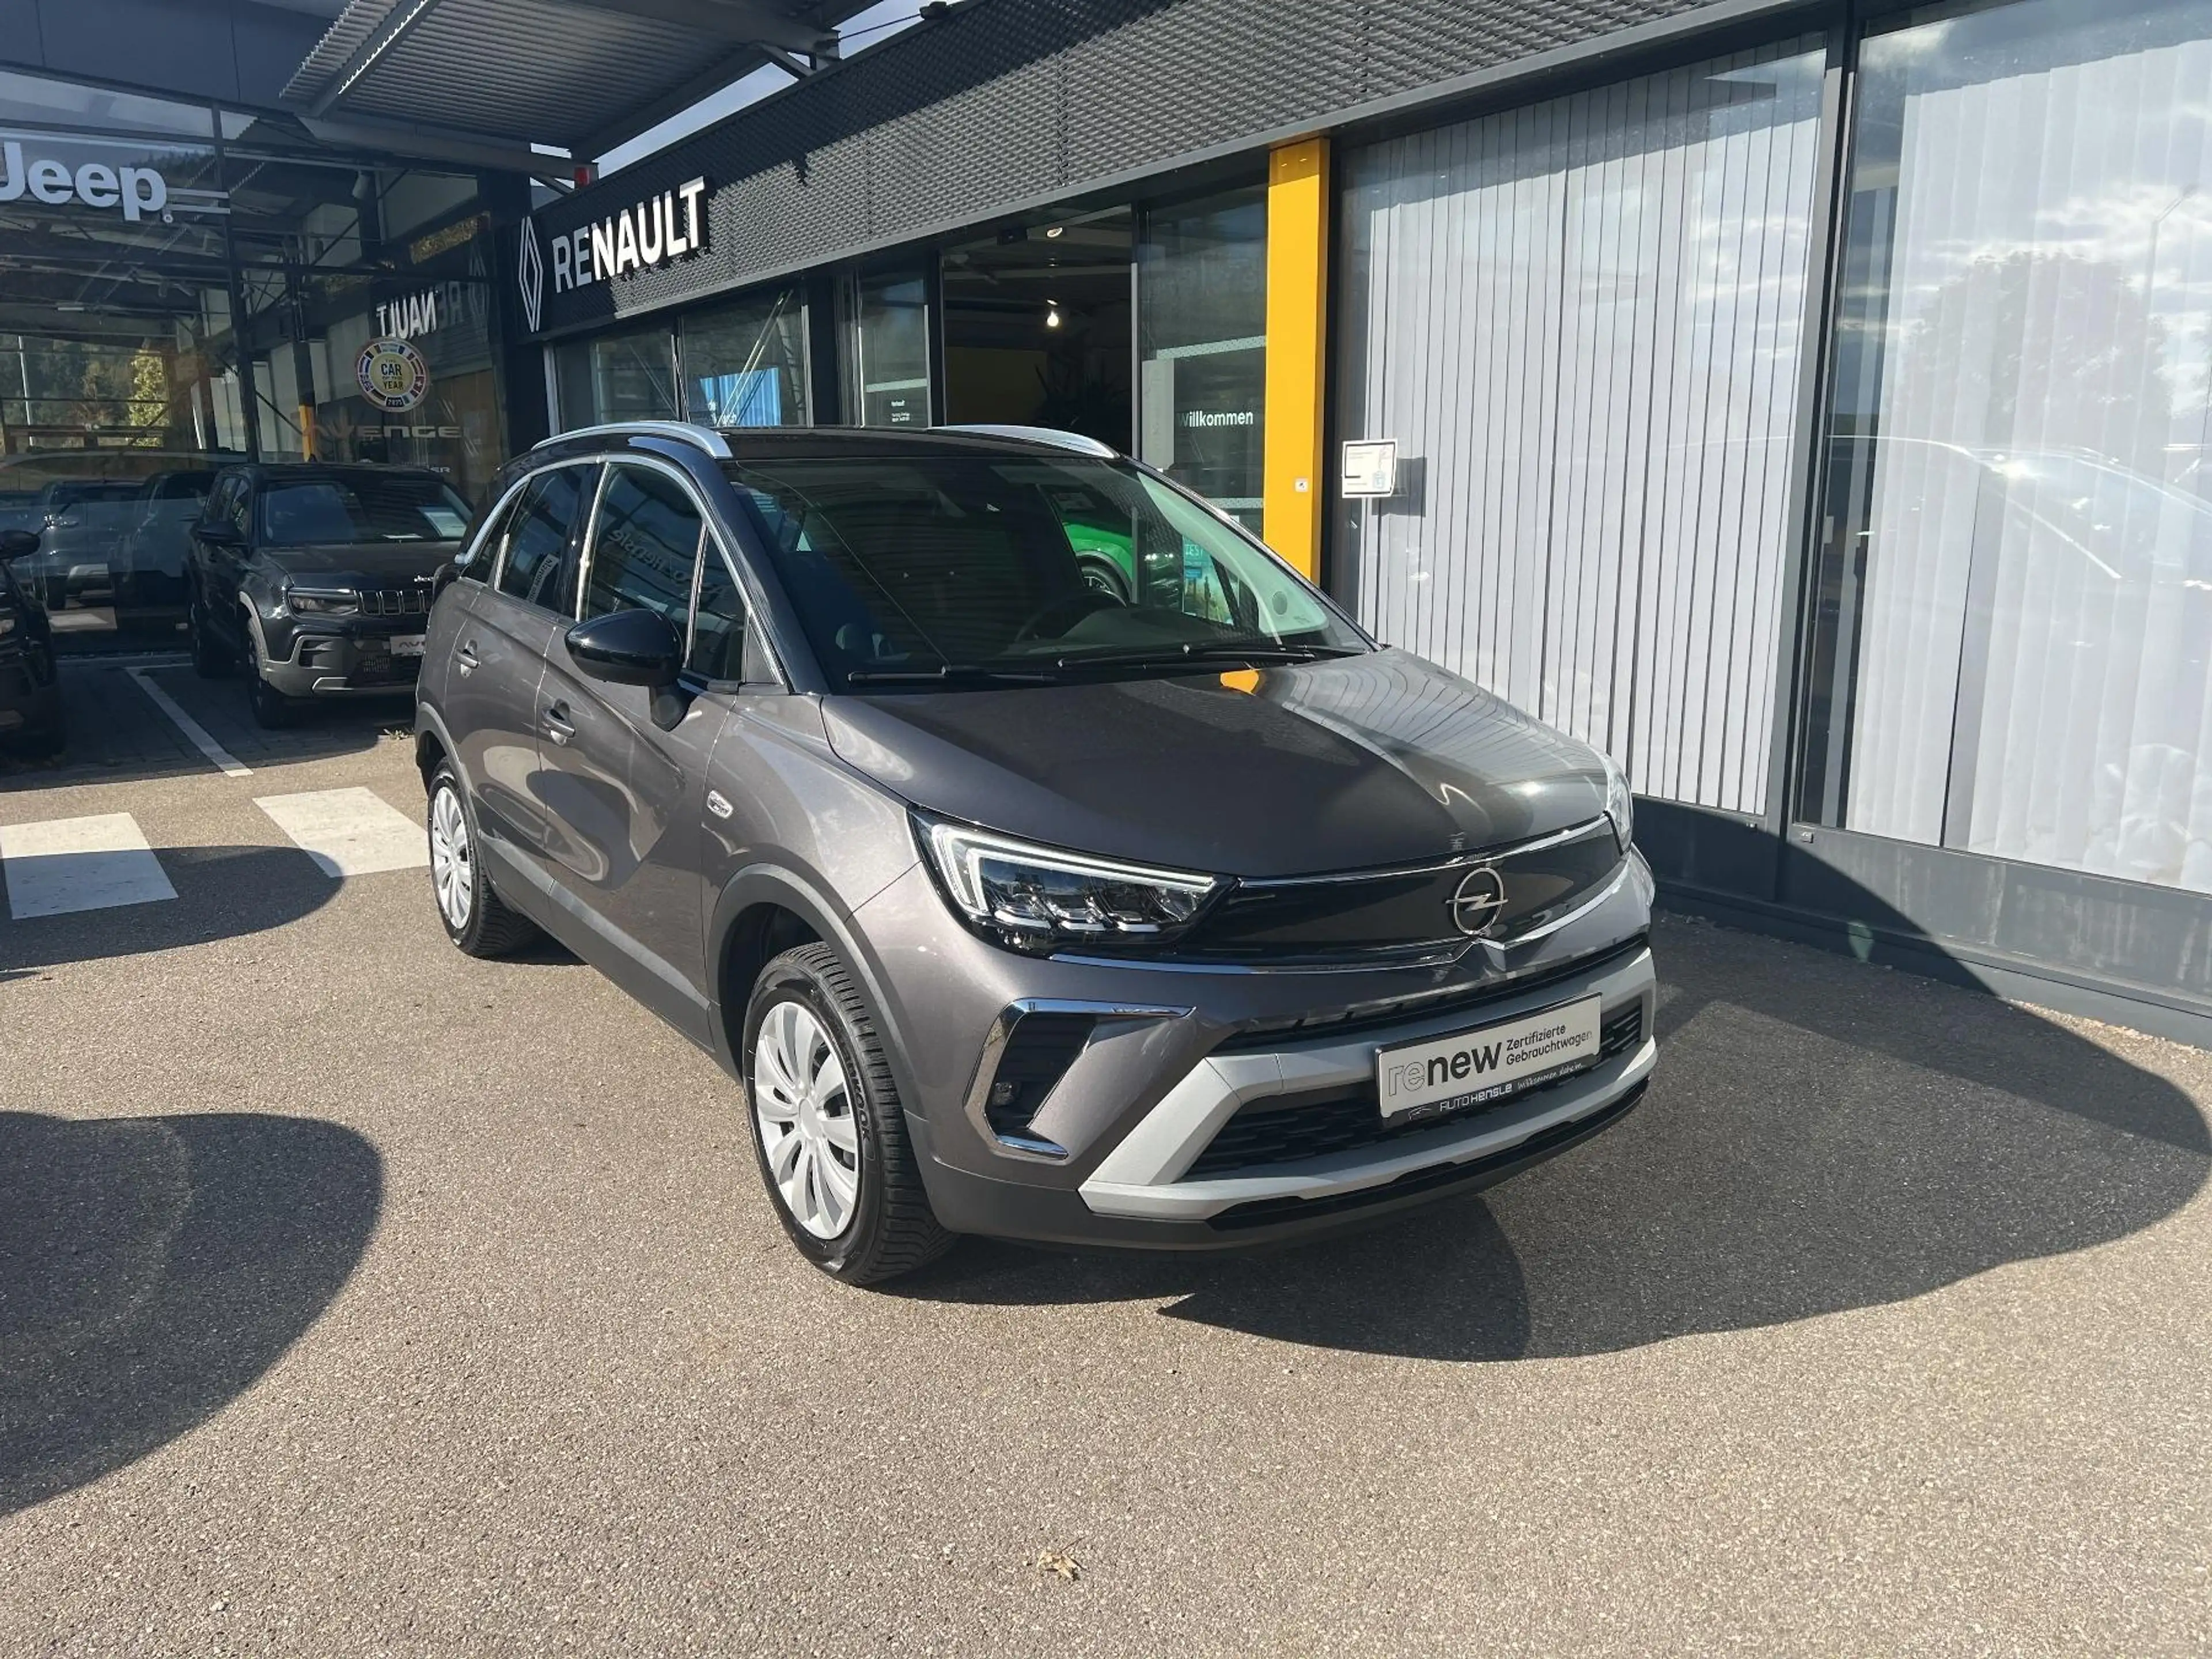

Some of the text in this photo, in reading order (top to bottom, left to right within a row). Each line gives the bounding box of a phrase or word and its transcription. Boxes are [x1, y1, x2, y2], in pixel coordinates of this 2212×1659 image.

[0, 141, 167, 221] Jeep
[551, 175, 704, 294] RENAULT
[381, 363, 403, 376] CAR
[382, 381, 404, 390] YEAR
[1177, 410, 1253, 427] Willkommen
[1506, 1024, 1566, 1051] Zertifizierte
[1506, 1030, 1593, 1065] Gebrauchtwagen
[1389, 1041, 1502, 1097] renew
